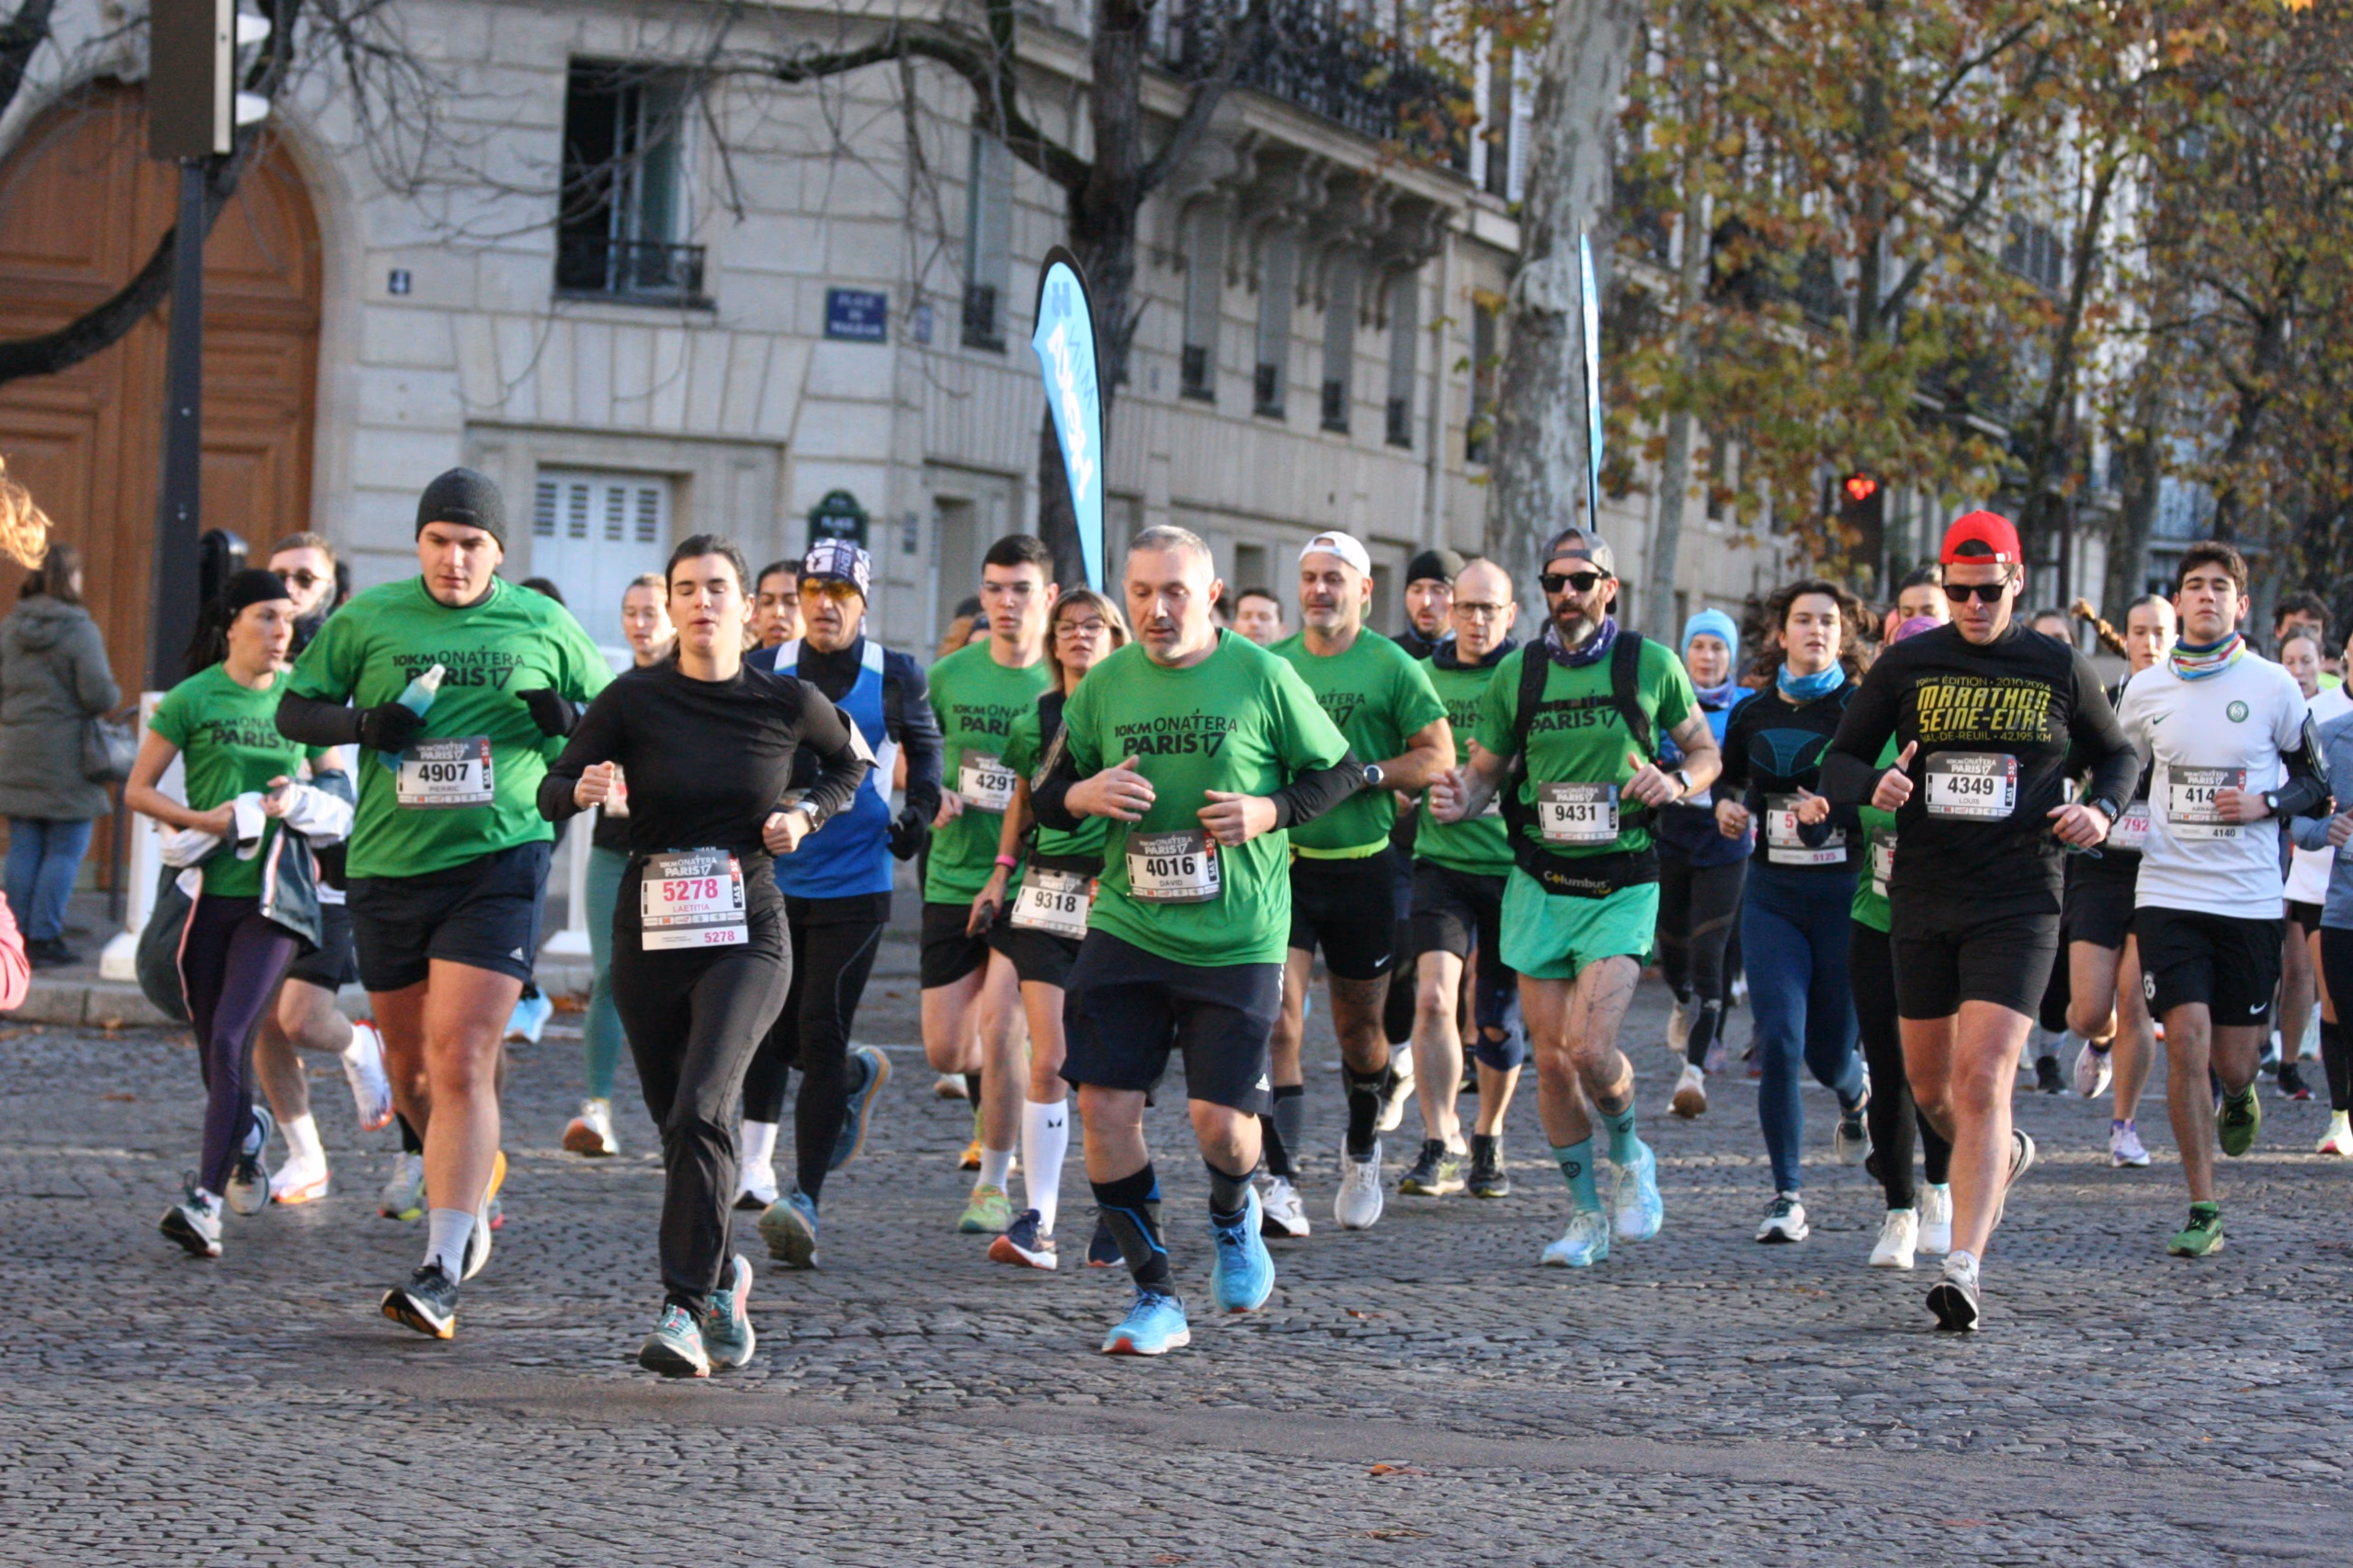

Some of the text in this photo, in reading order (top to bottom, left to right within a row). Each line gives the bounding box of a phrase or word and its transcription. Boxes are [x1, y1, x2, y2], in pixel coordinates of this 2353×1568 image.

[392, 653, 435, 666] 10KM
[405, 666, 514, 691] PRIS 17
[1916, 685, 2052, 710] MARATHON
[961, 716, 1011, 736] PARI
[1529, 709, 1597, 735] PARIS
[1919, 708, 2049, 733] SEINE-EURE
[1114, 722, 1152, 738] 10KM
[1920, 732, 2052, 744] VAL-DE-REUIL 42,195 KM
[211, 729, 280, 749] PARIS
[1123, 733, 1227, 758] PARIS 17
[418, 763, 470, 782] 4907
[1951, 765, 1981, 774] PARIS
[976, 774, 1017, 791] 4291
[1948, 777, 1995, 795] 4349
[2185, 788, 2225, 803] 414
[1555, 805, 1597, 821] 9431
[2123, 817, 2150, 833] 792
[2212, 828, 2236, 837] 4140
[1144, 846, 1176, 855] PARIS
[1813, 852, 1836, 862] 5125
[665, 866, 699, 877] PARIS
[1146, 857, 1195, 877] 4016
[663, 878, 719, 902] 5278
[733, 885, 742, 903] SAS
[673, 903, 710, 913] LAETITIA
[1035, 891, 1076, 913] 9318
[704, 930, 735, 943] 5278
